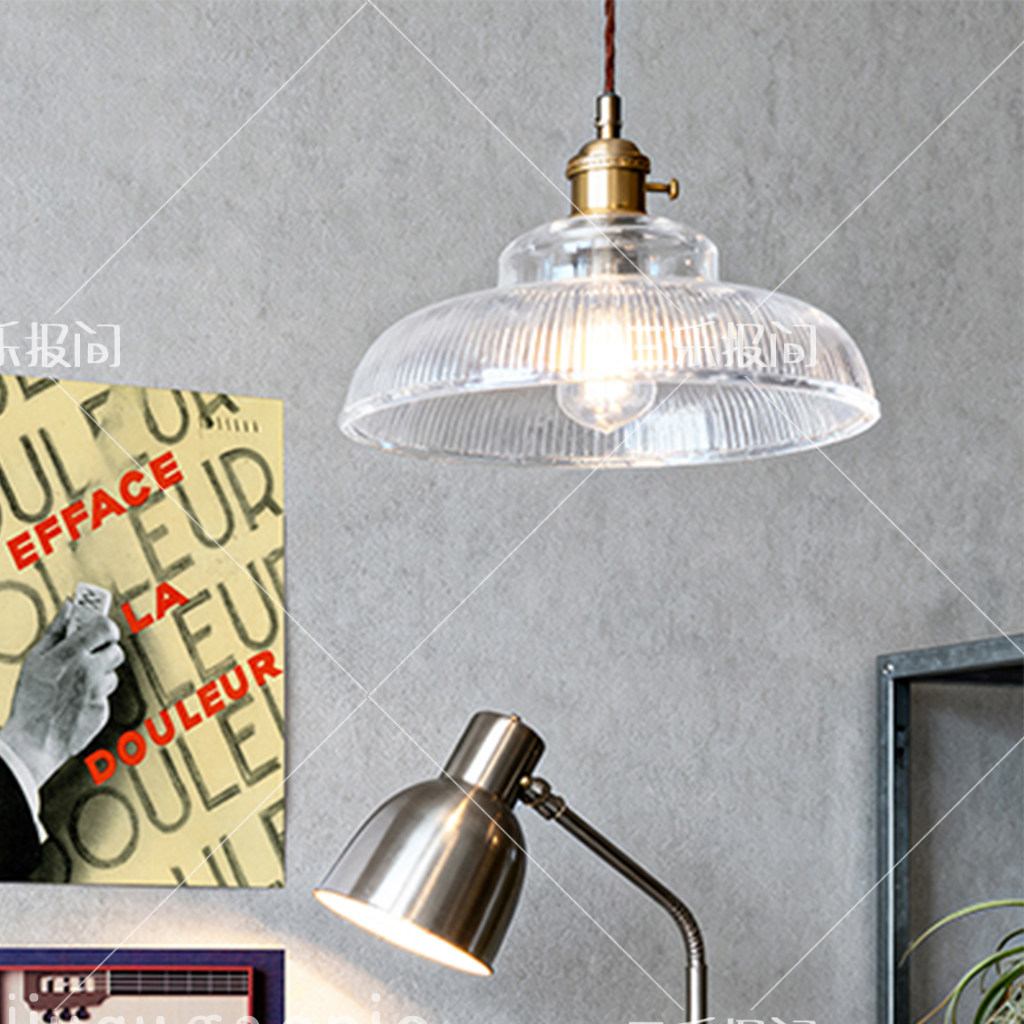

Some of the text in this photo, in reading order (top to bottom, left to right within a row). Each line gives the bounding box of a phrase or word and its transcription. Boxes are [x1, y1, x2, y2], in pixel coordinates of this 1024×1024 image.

[6, 451, 184, 570] EFFACE
[121, 581, 189, 635] LA
[84, 650, 283, 786] DOULEUR
